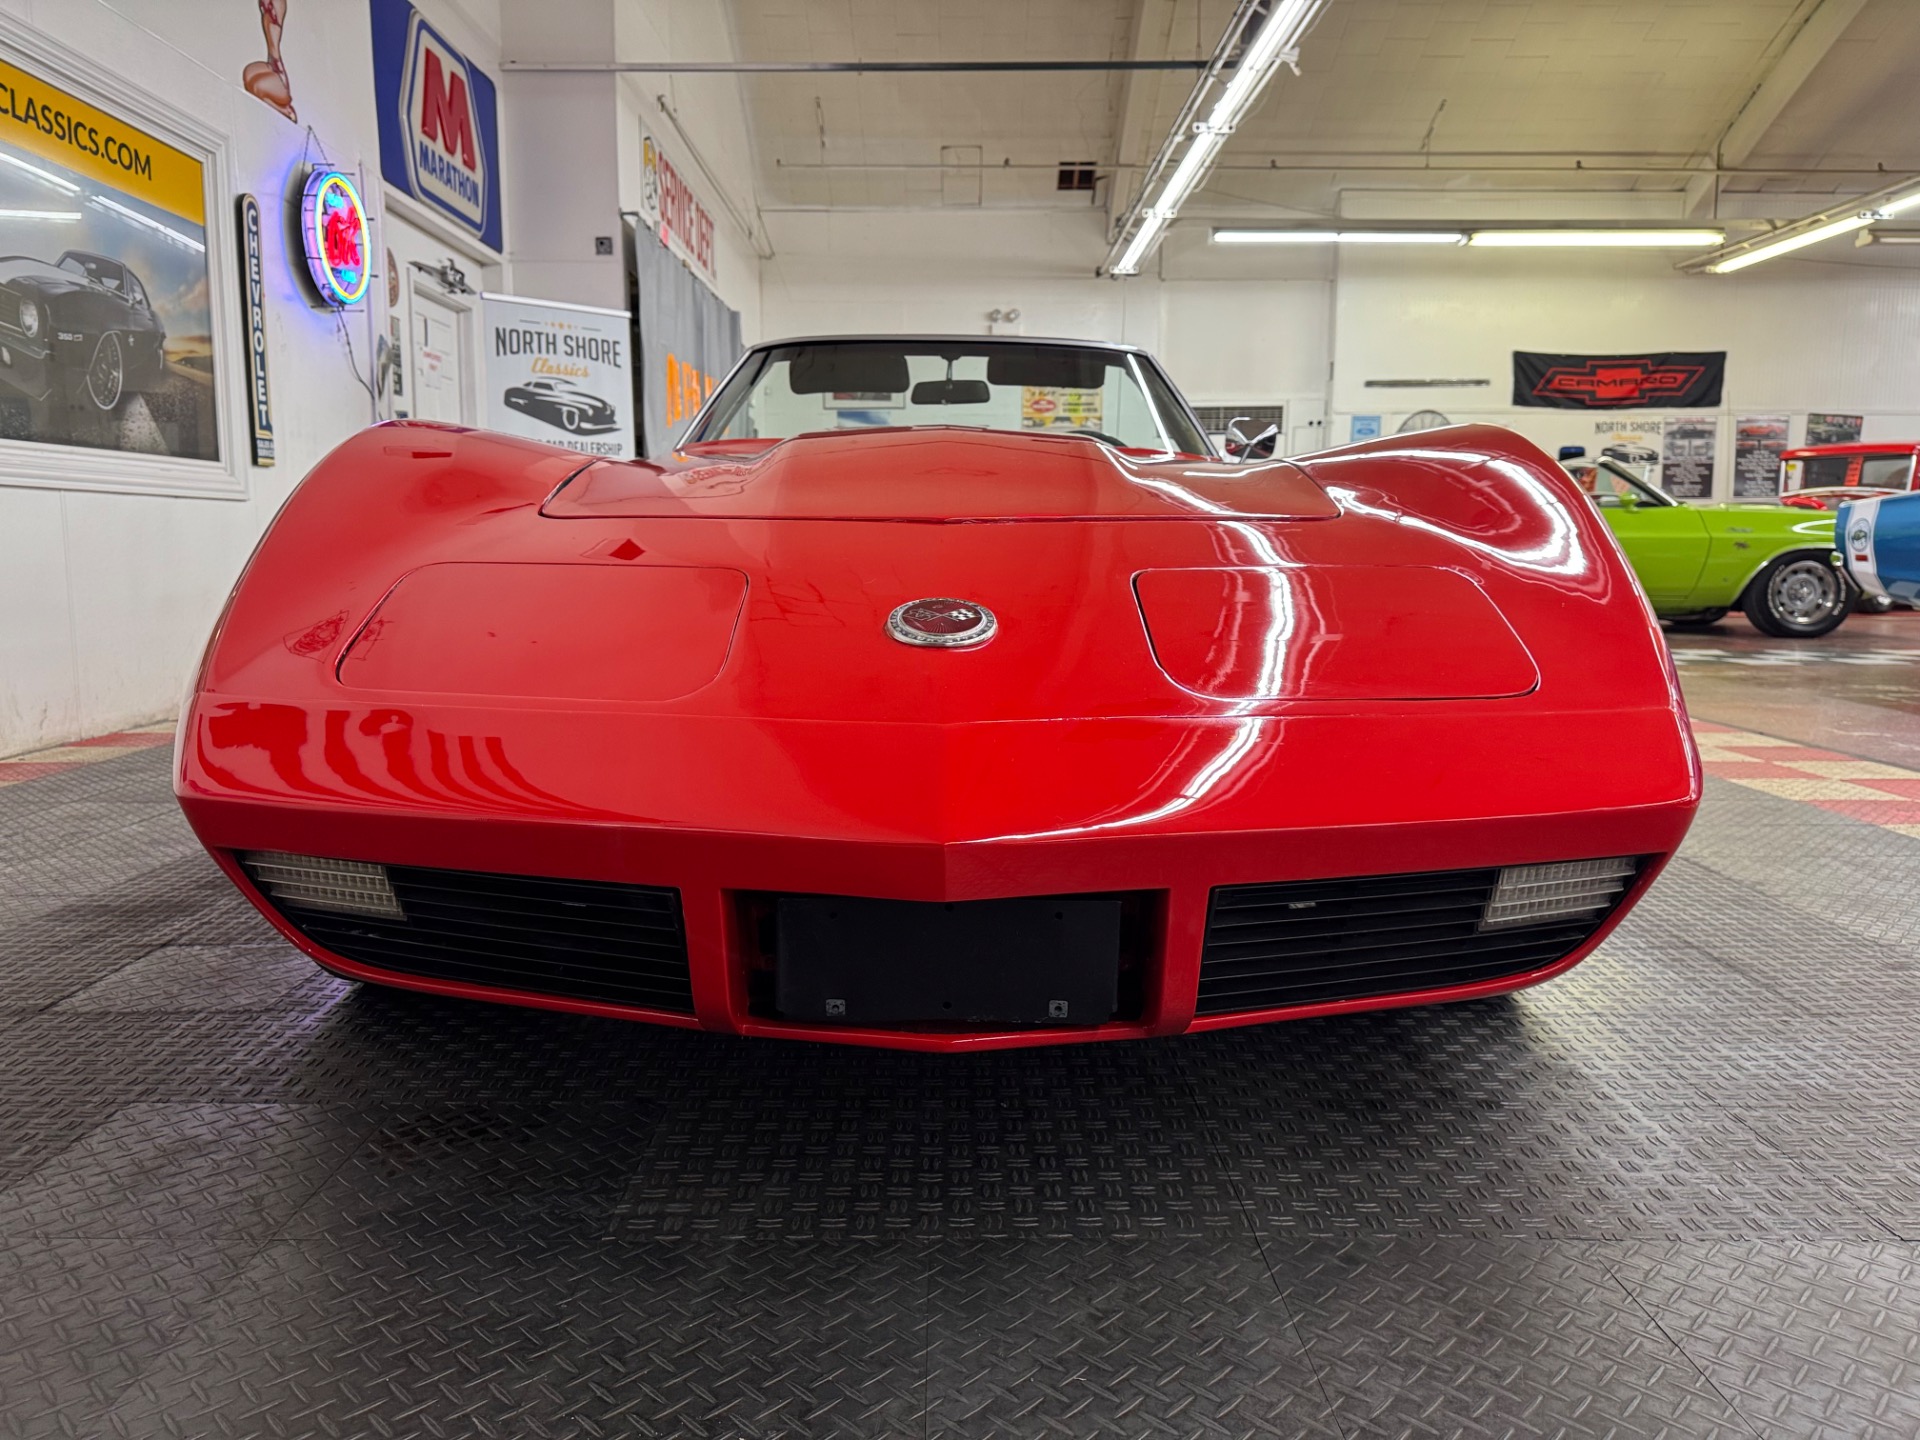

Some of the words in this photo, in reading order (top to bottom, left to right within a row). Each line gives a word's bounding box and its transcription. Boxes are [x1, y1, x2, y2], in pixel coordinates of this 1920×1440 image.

[421, 46, 476, 174] M
[419, 140, 480, 208] MARATHON
[658, 151, 694, 254] SERVICE
[247, 208, 268, 427] CHEVROLET
[495, 326, 557, 357] NORTH
[563, 334, 622, 369] SHORE
[531, 356, 590, 378] Classics
[1557, 374, 1678, 388] CAMARO
[1594, 421, 1627, 434] NORTH
[1630, 421, 1662, 435] SHORE
